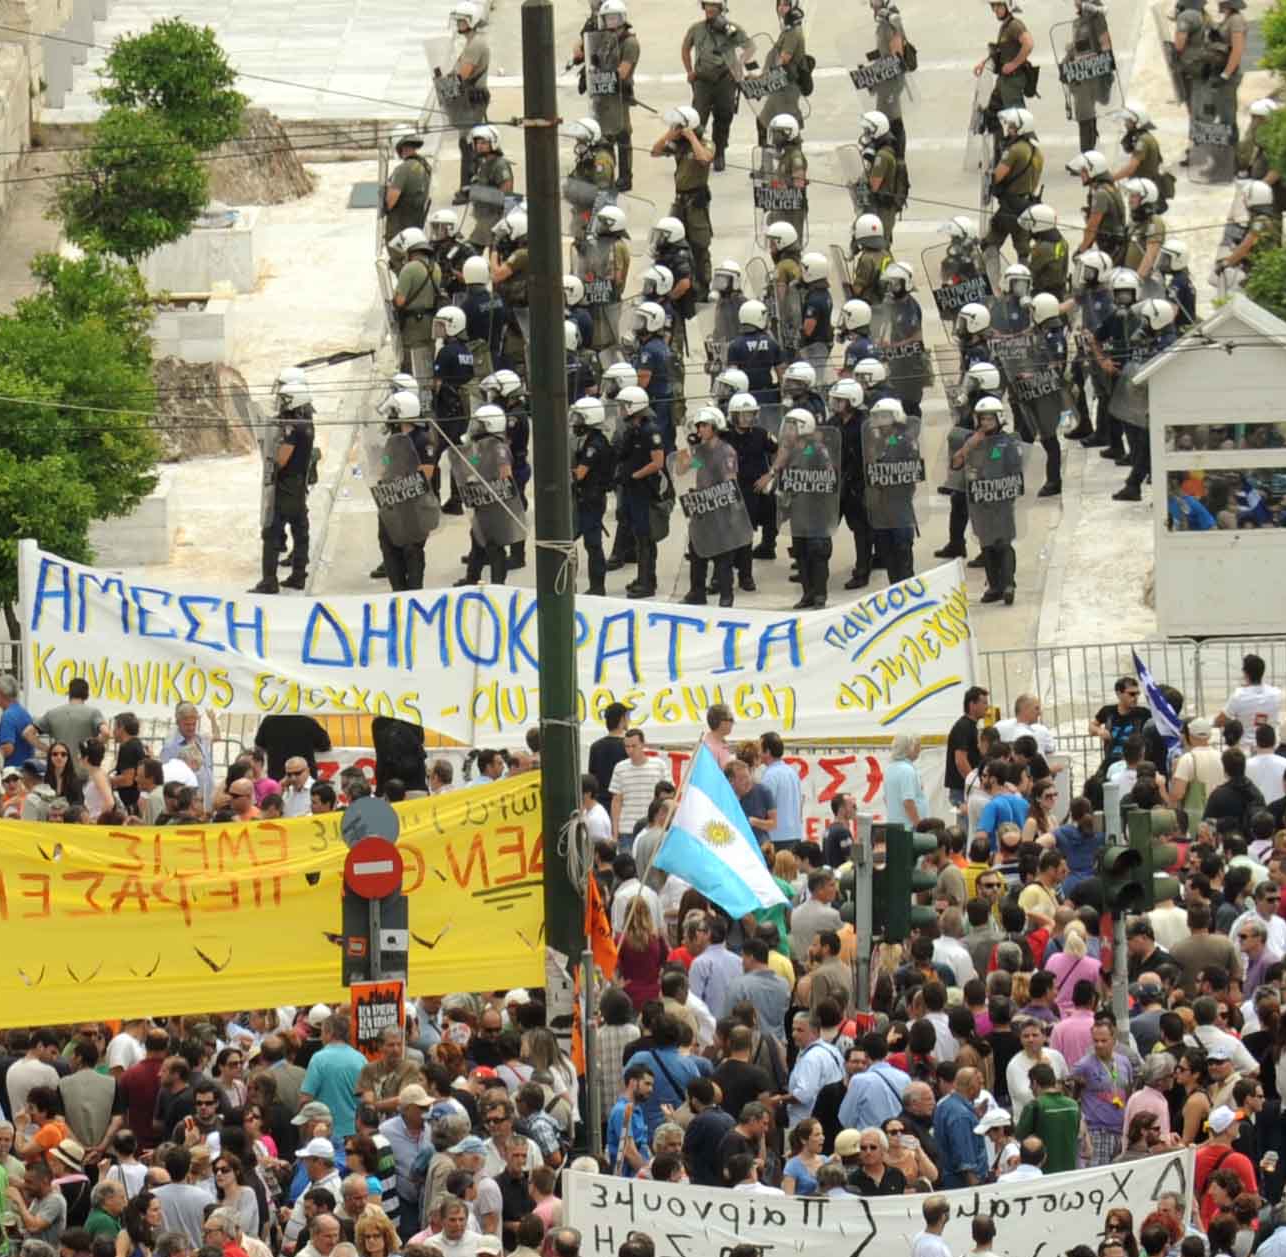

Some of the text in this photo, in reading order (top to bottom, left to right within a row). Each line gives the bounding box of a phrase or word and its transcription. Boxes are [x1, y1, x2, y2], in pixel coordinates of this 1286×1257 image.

[857, 67, 901, 88] POLICE
[1067, 65, 1112, 82] POLICE
[758, 198, 802, 210] POLICE
[870, 471, 921, 486] POLICE
[783, 481, 834, 494] POLICE
[973, 486, 1021, 503] POLICE
[378, 486, 427, 508] POLICE
[688, 492, 738, 515] POLICE
[30, 556, 804, 684] ΑΜΕΣΗ ΔΗΜΟΚΑΤΙΑ
